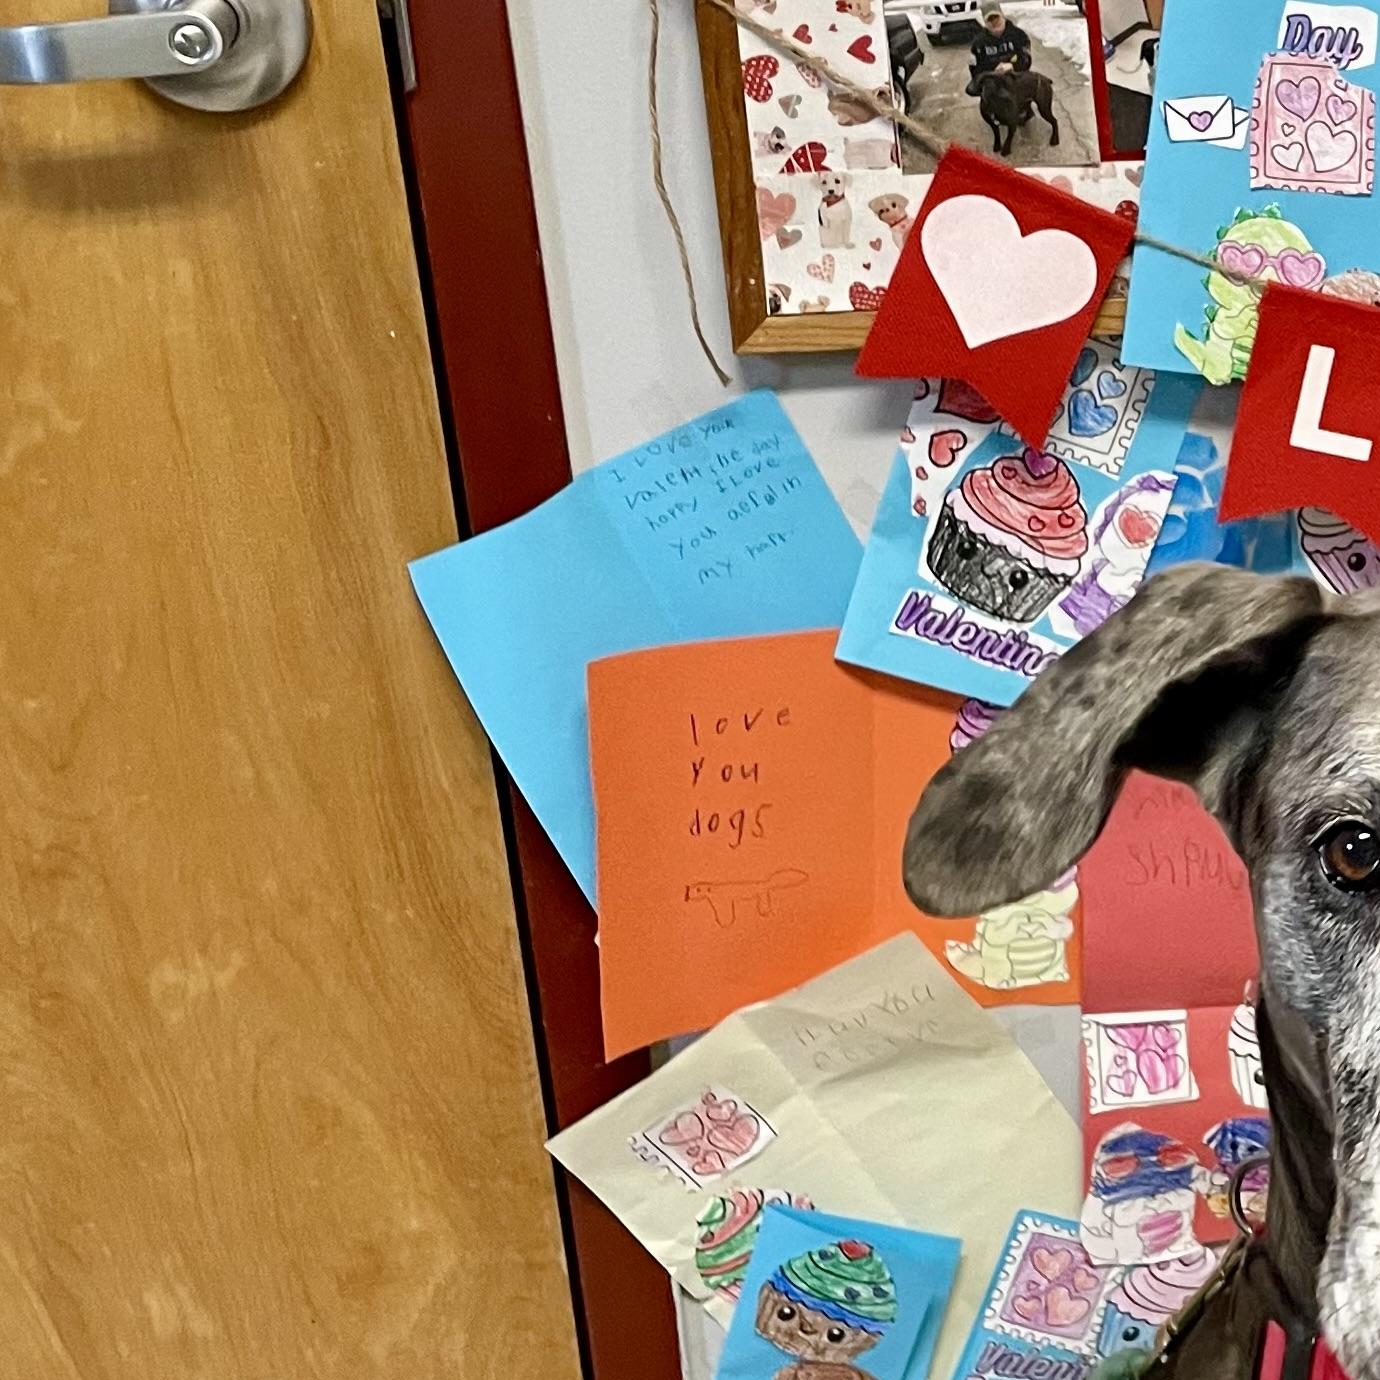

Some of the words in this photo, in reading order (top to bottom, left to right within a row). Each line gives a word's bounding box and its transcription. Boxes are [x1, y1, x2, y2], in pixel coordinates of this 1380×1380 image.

[1284, 14, 1362, 70] Day
[690, 707, 790, 746] love
[690, 803, 773, 849] dogs
